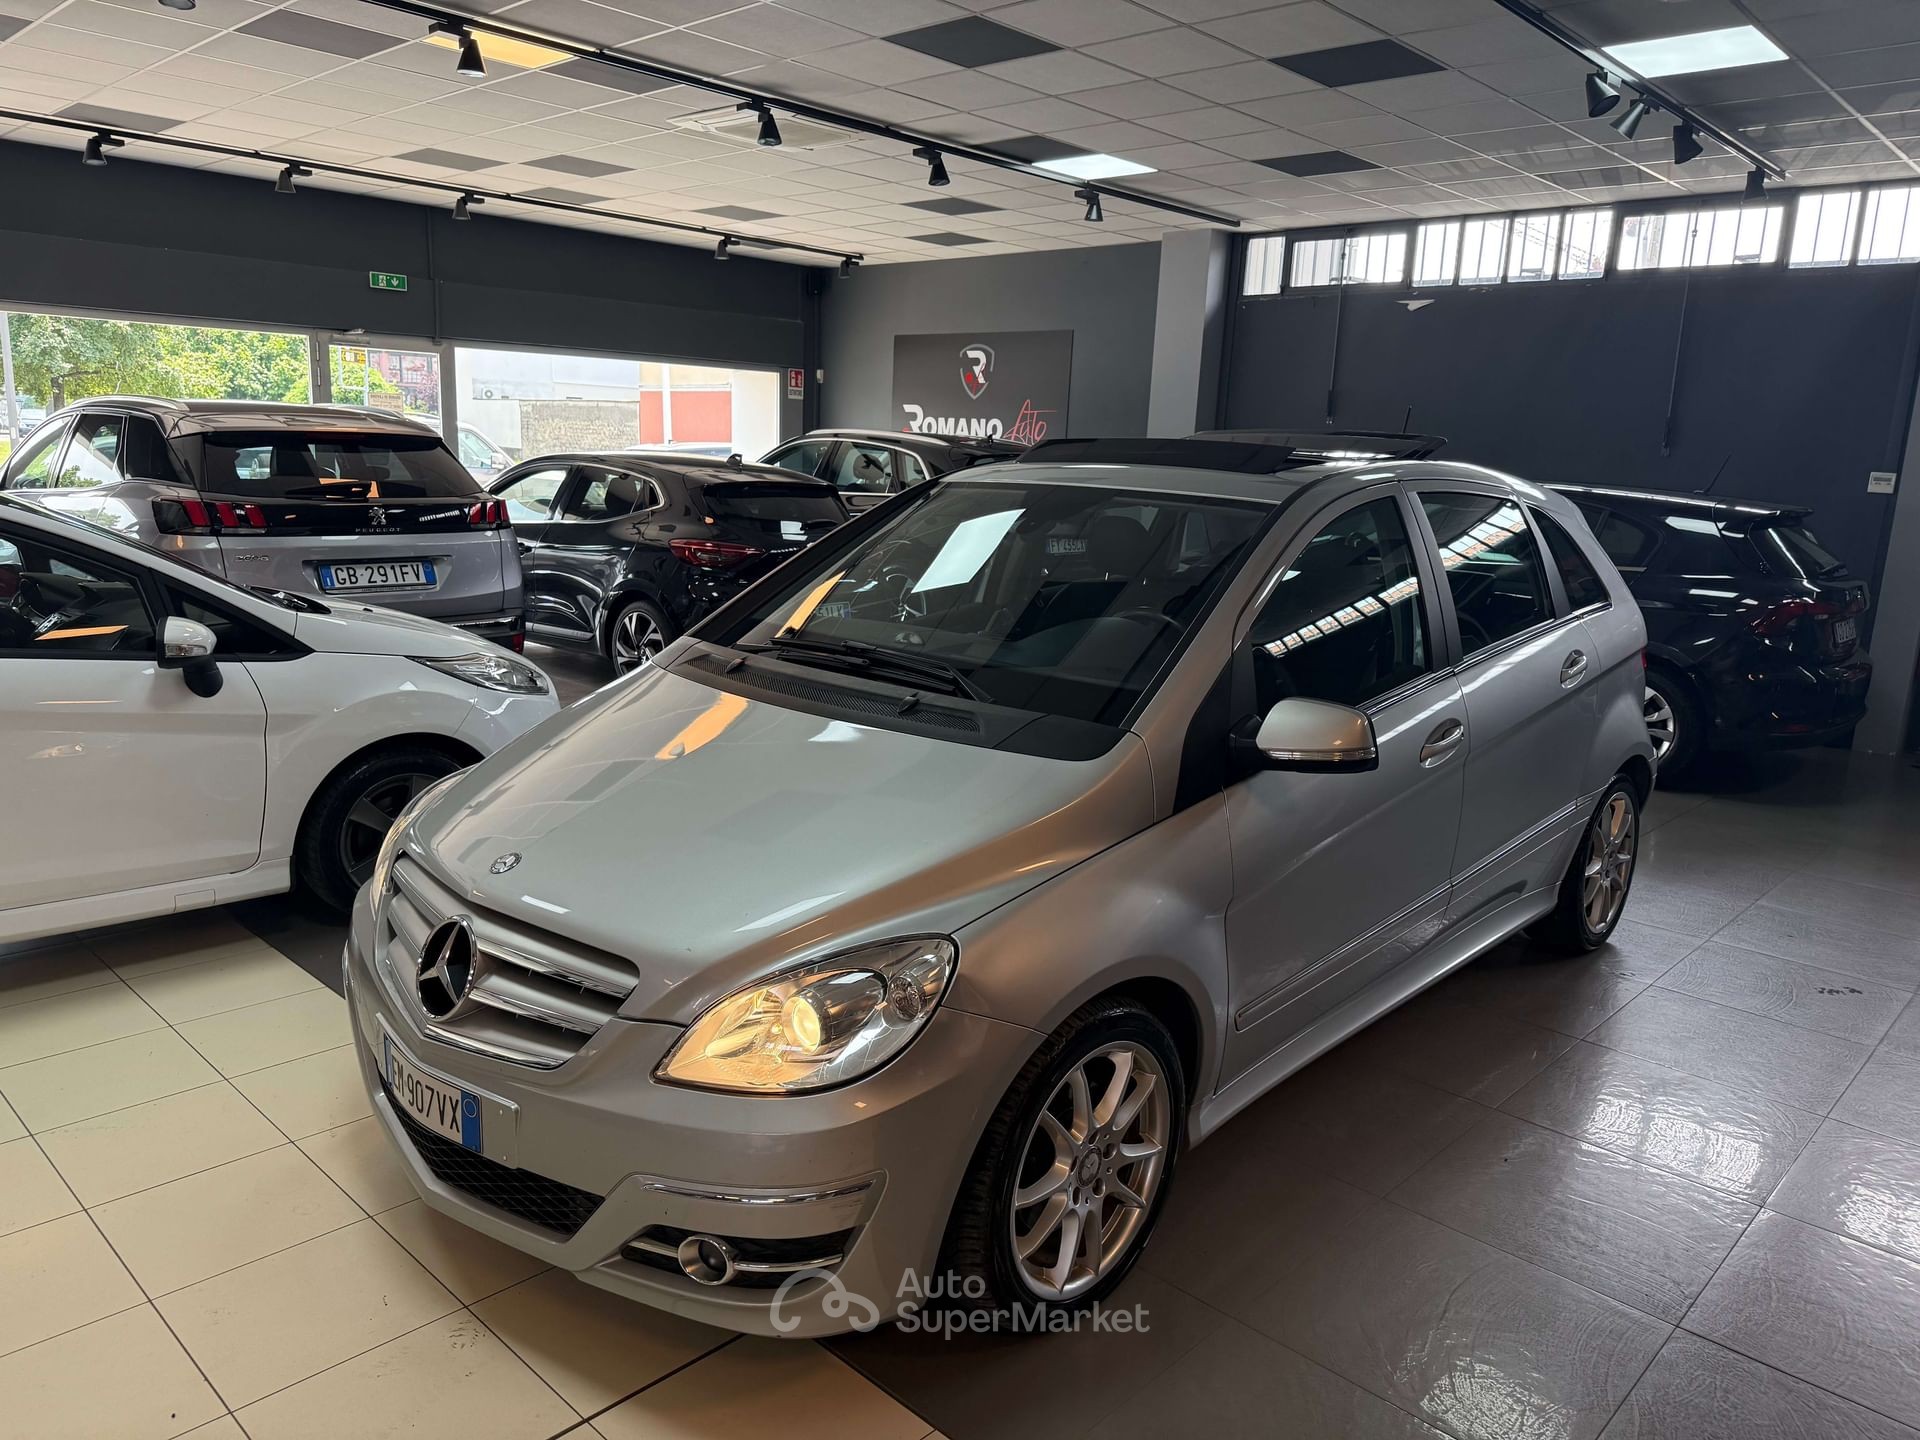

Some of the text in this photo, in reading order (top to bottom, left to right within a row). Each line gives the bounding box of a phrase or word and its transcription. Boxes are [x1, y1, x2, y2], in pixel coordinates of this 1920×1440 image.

[902, 403, 1004, 440] ROMANO
[334, 566, 359, 585] GB
[364, 563, 421, 584] 291FV
[407, 1073, 460, 1133] 907VX
